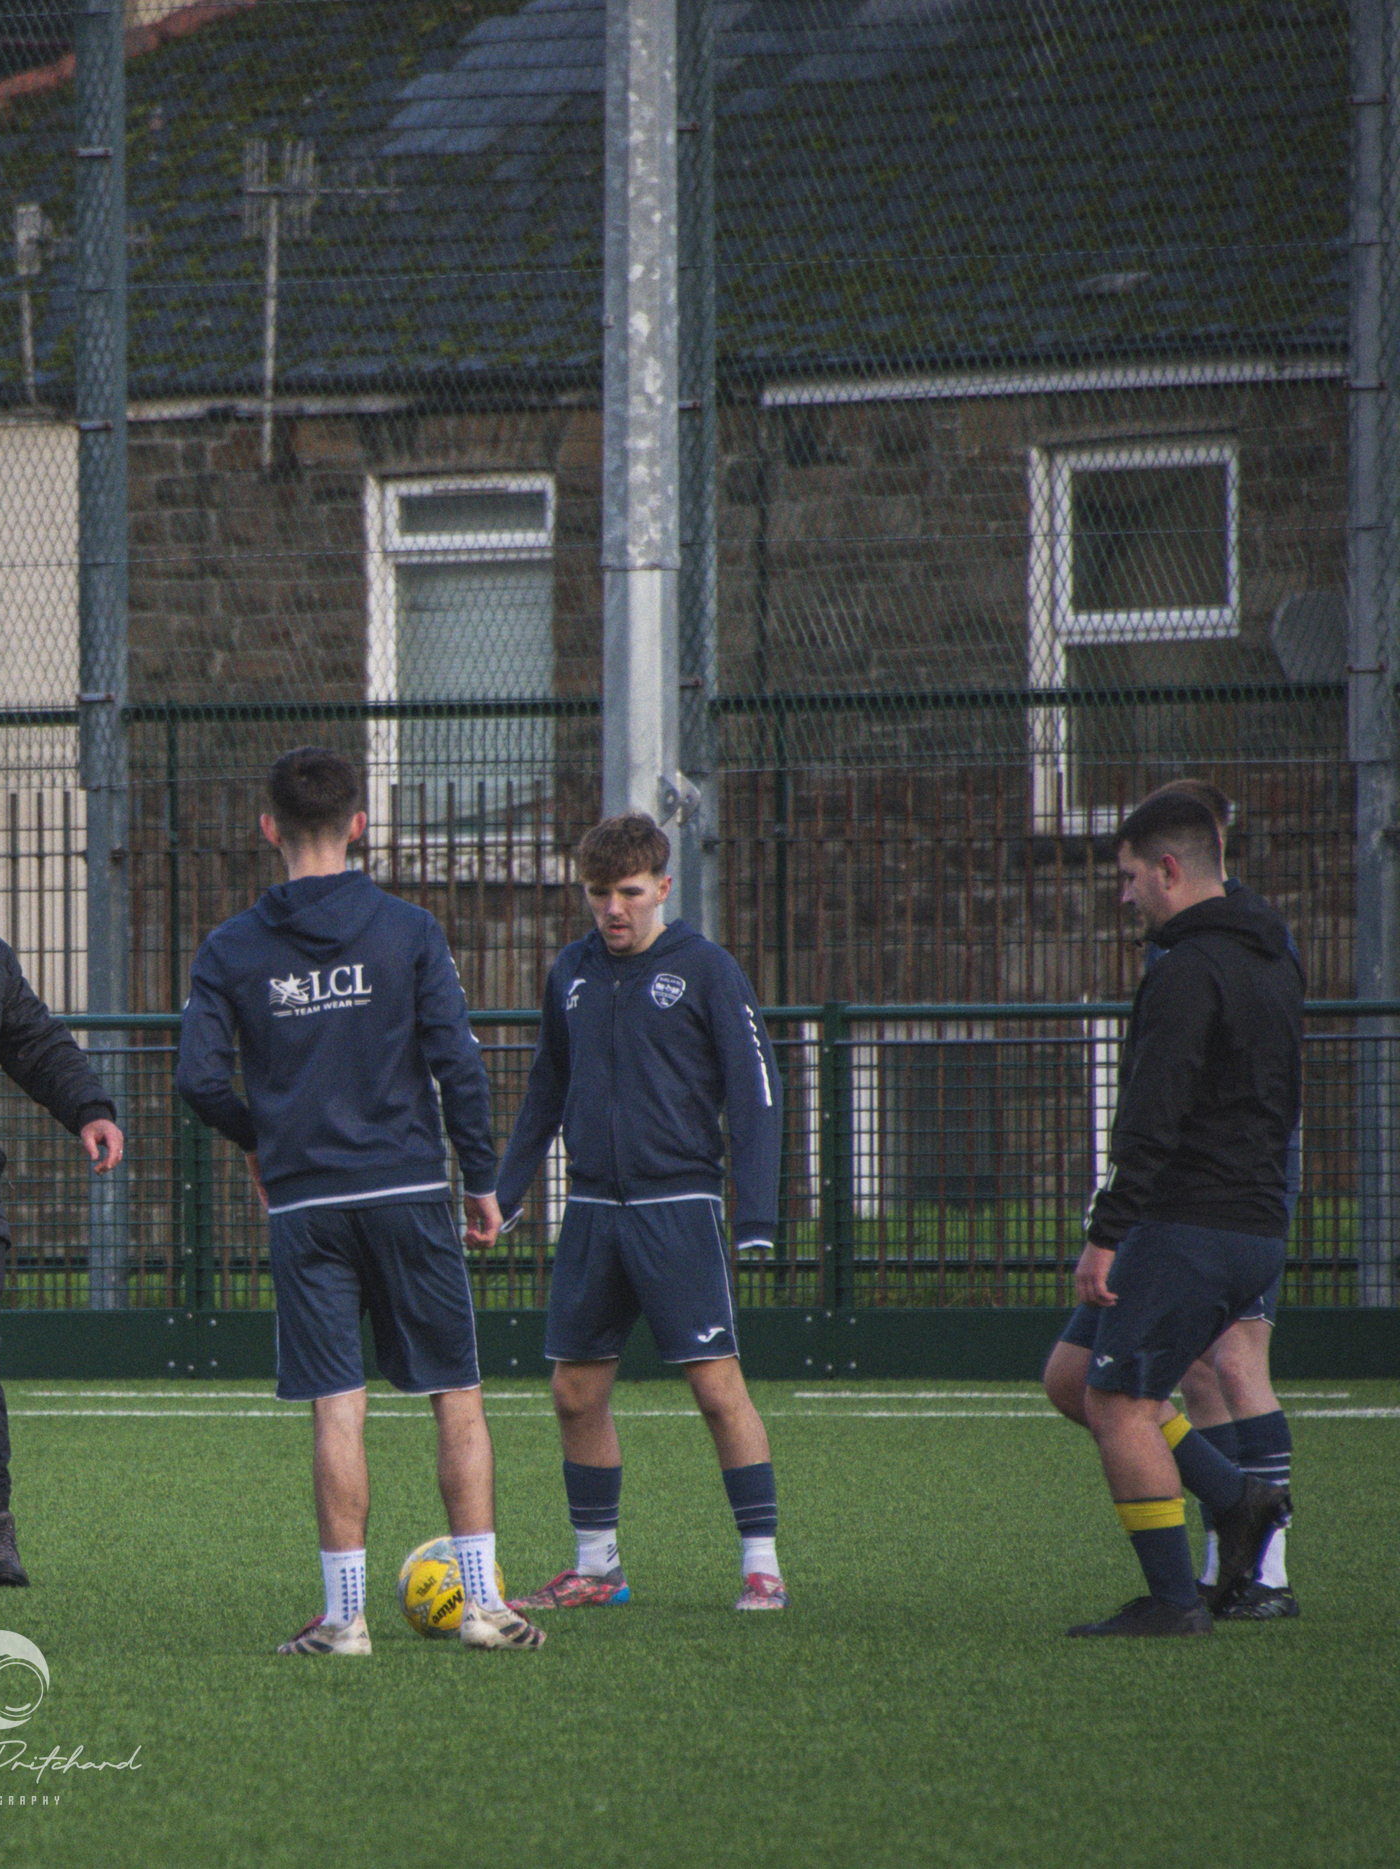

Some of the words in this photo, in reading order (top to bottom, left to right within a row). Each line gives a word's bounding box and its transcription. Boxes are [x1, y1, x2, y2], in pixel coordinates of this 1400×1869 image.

[309, 963, 372, 1002] LCL
[293, 1005, 320, 1017] TEAM
[323, 999, 353, 1011] WEAR
